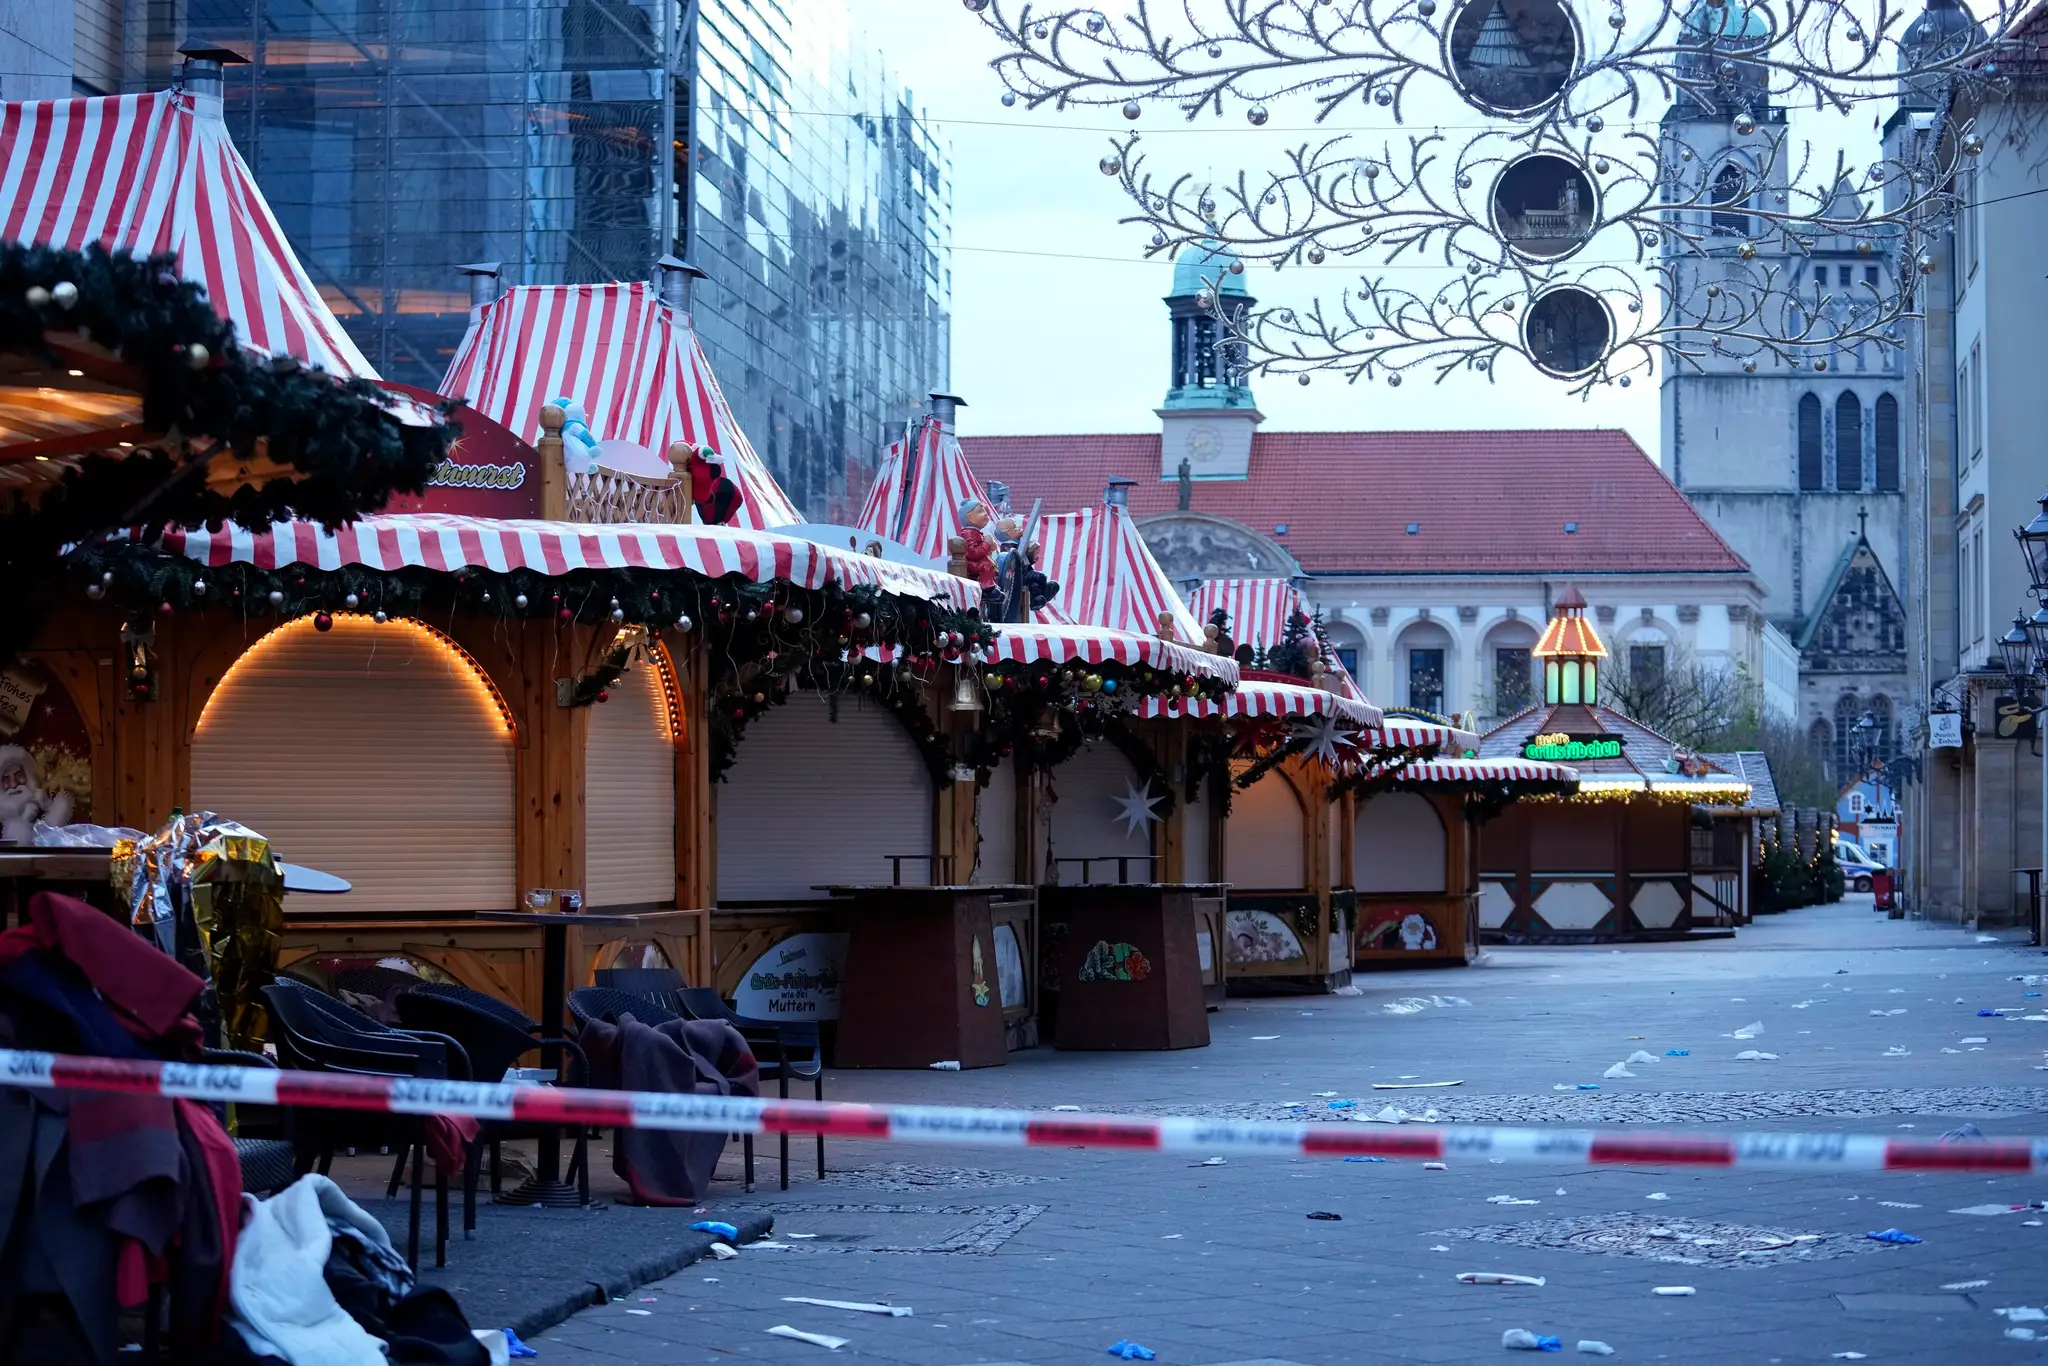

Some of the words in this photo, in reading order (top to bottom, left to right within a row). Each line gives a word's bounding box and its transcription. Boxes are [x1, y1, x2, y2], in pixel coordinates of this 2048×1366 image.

[0, 677, 32, 703] Frohes
[0, 695, 18, 716] Fest
[1526, 740, 1620, 759] Grillstübchen
[781, 991, 794, 999] wie
[796, 989, 809, 999] bei
[769, 999, 816, 1013] Muttern
